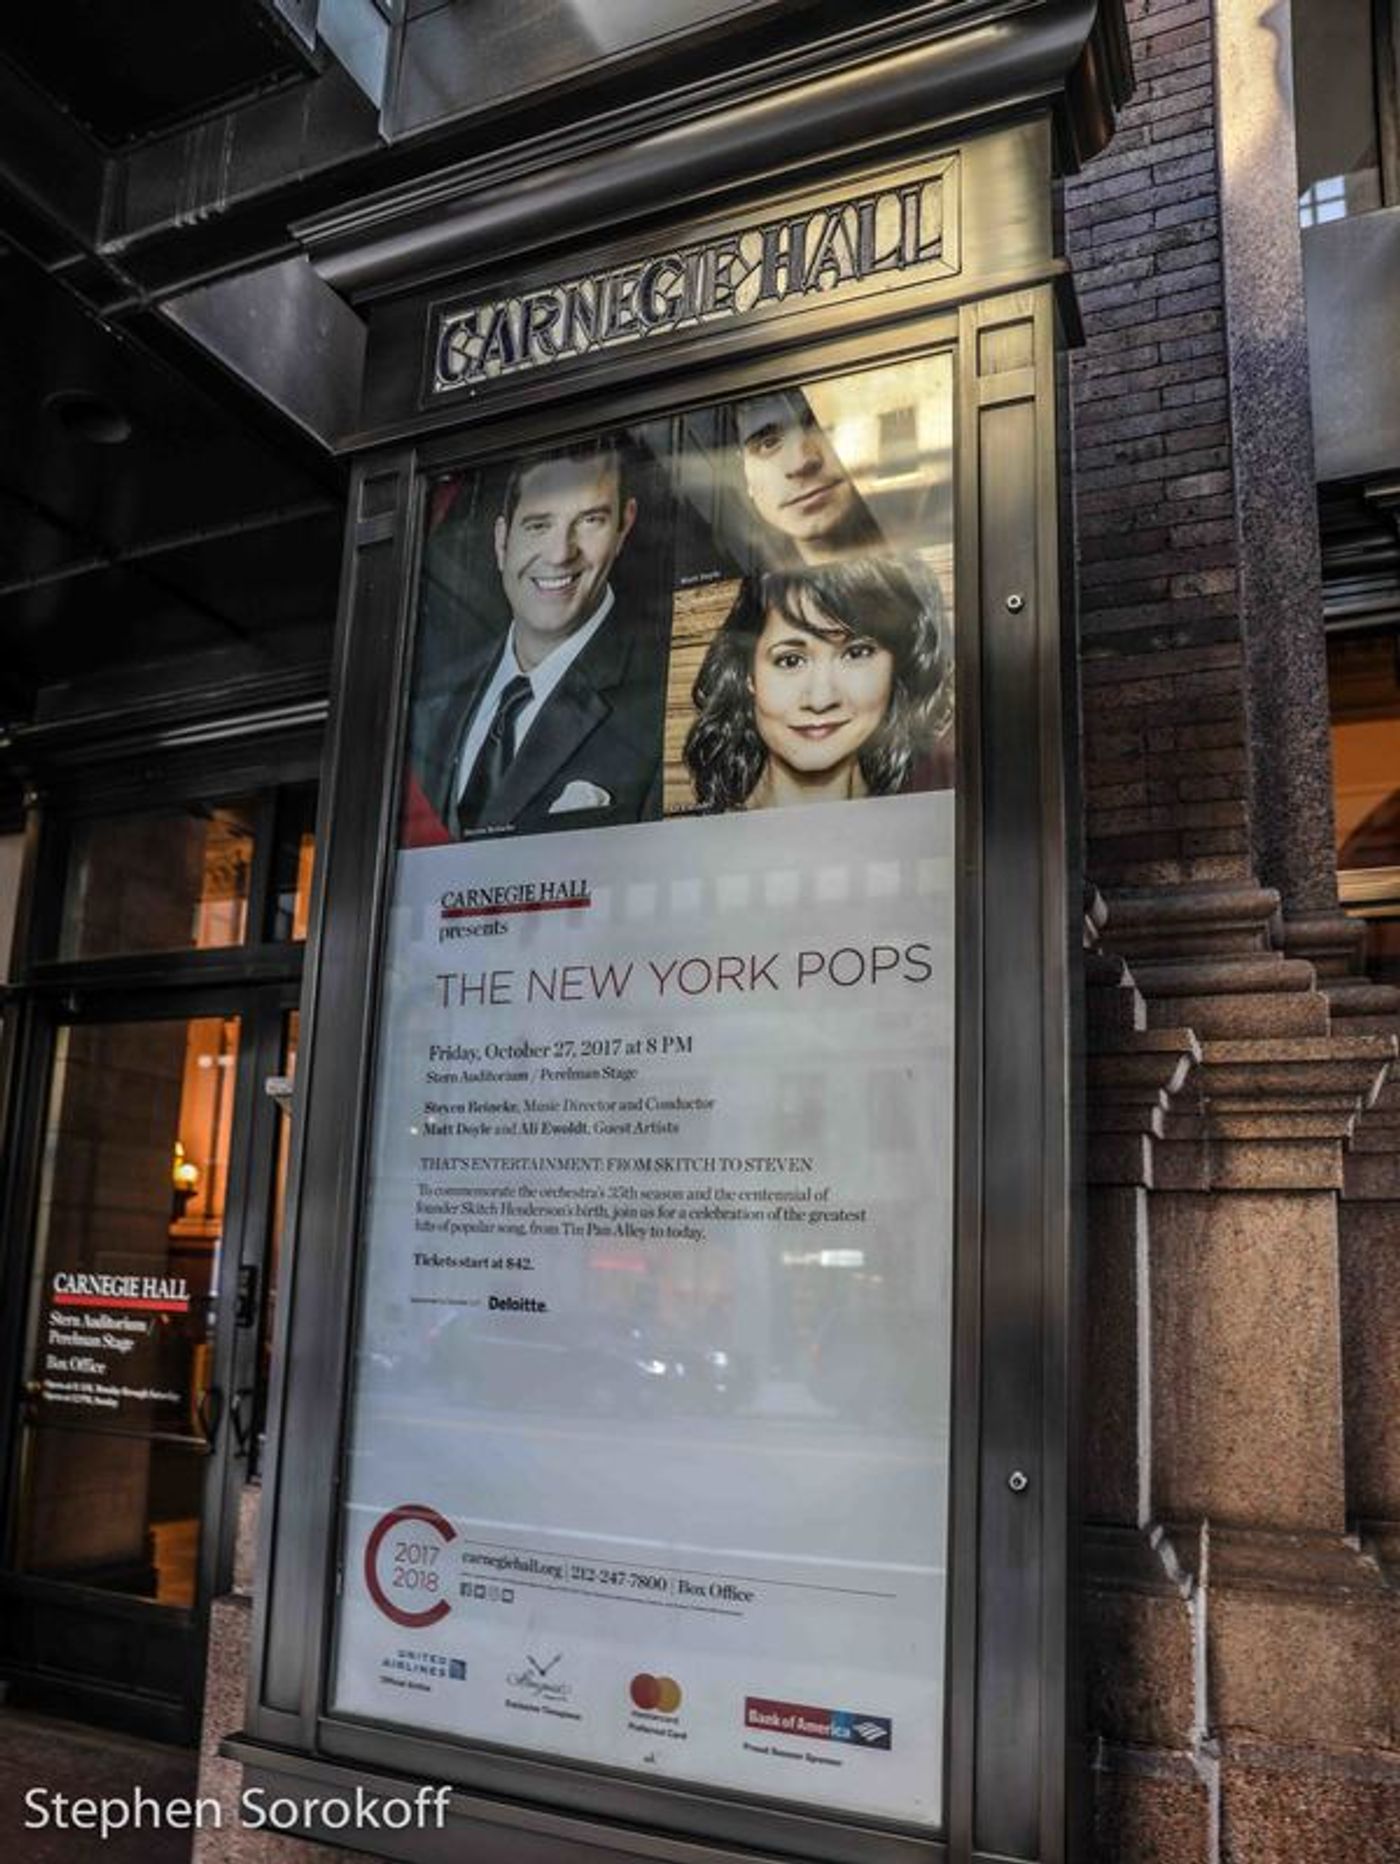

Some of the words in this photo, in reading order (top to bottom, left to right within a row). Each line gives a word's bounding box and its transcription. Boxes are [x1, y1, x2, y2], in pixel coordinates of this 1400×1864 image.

[439, 237, 740, 384] CARNEGIE
[758, 180, 942, 299] HALL
[441, 882, 537, 909] CARNEGIE
[539, 879, 592, 902] HALL
[438, 919, 509, 944] presents
[436, 969, 515, 1009] THE
[526, 962, 634, 1003] NEW
[648, 952, 780, 997] YORK
[798, 942, 934, 990] POPS
[428, 1044, 482, 1064] Friday,
[484, 1041, 550, 1061] October
[552, 1040, 577, 1058] 27,
[581, 1038, 623, 1056] 2017
[625, 1040, 641, 1055] at
[645, 1038, 657, 1053] 8
[662, 1036, 693, 1054] PM
[426, 1071, 458, 1084] Stern
[462, 1069, 529, 1083] Auditorium
[540, 1066, 600, 1081] Perelman
[602, 1066, 640, 1081] Stage
[424, 1100, 465, 1114] Steven
[523, 1099, 560, 1113] Music
[562, 1098, 616, 1112] Director
[618, 1098, 643, 1112] and
[645, 1096, 715, 1111] Conductor
[423, 1122, 454, 1137] Matt
[456, 1122, 491, 1138] Doyle
[494, 1122, 517, 1136] and
[592, 1122, 631, 1136] Guest
[632, 1120, 680, 1135] Artists
[419, 1157, 471, 1171] THAT'S
[606, 1157, 652, 1172] FROM
[654, 1157, 716, 1172] SKITCH
[719, 1157, 743, 1172] TO
[743, 1156, 814, 1173] STEVEN
[418, 1183, 432, 1197] To
[518, 1184, 536, 1198] the
[687, 1187, 713, 1200] and
[714, 1187, 737, 1201] the
[738, 1187, 812, 1202] centennial
[814, 1187, 830, 1202] of
[460, 1201, 499, 1216] Skitch
[501, 1201, 573, 1217] Henderson's
[611, 1204, 638, 1221] join
[640, 1207, 656, 1218] us
[656, 1206, 677, 1220] for
[678, 1209, 687, 1220] a
[688, 1205, 765, 1222] celebration
[766, 1206, 783, 1222] of
[783, 1206, 806, 1222] the
[807, 1208, 868, 1225] greatest
[450, 1220, 495, 1235] popular
[529, 1221, 560, 1236] from
[561, 1222, 585, 1237] Tin
[613, 1223, 647, 1240] Alley
[650, 1225, 665, 1238] to
[413, 1252, 458, 1267] Tickets
[458, 1254, 489, 1268] start
[491, 1256, 504, 1269] at
[53, 1272, 141, 1299] CARNEGIE
[142, 1276, 191, 1301] HALL
[49, 1310, 81, 1328] Stern
[82, 1313, 148, 1333] Auditorium
[102, 1332, 136, 1354] Stage
[46, 1354, 68, 1371] Box
[69, 1356, 107, 1375] Office
[394, 1541, 440, 1566] 2017
[391, 1565, 440, 1592] 2018
[571, 1565, 668, 1592] 212-247-7800
[678, 1579, 706, 1597] Box
[708, 1583, 754, 1603] Office
[381, 1658, 447, 1678] AIRLINES
[397, 1649, 447, 1665] UNITED
[748, 1708, 781, 1727] Bank
[781, 1715, 796, 1730] of
[796, 1716, 851, 1738] America
